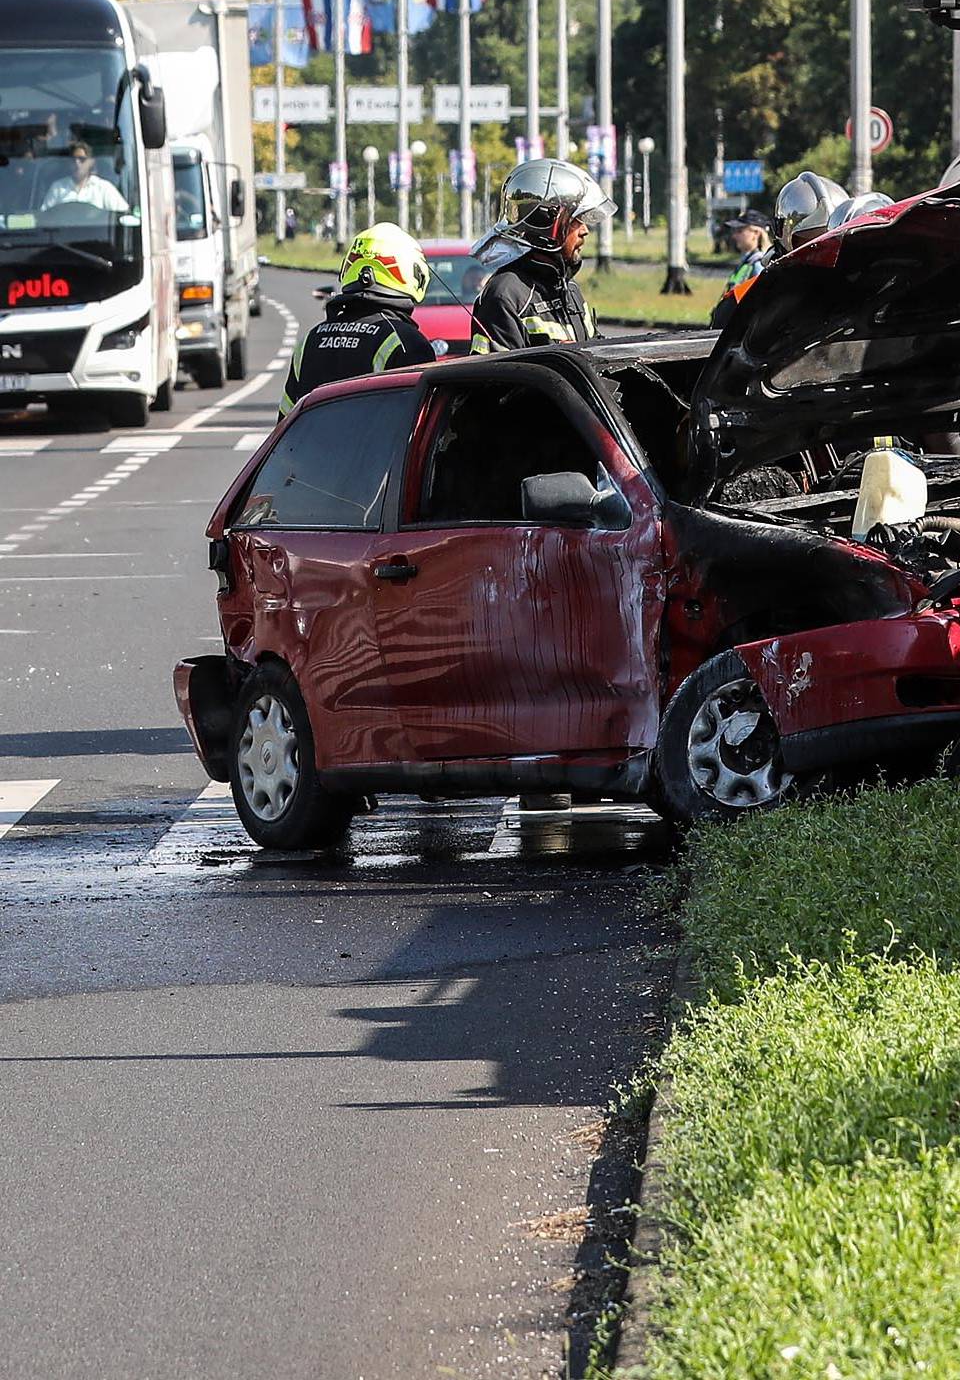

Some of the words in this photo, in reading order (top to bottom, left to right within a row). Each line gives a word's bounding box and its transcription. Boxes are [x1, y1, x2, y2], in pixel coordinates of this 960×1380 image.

[8, 273, 70, 306] pula
[316, 321, 380, 336] VATROGASCI
[318, 336, 361, 349] ZAGREB
[1, 343, 23, 359] N
